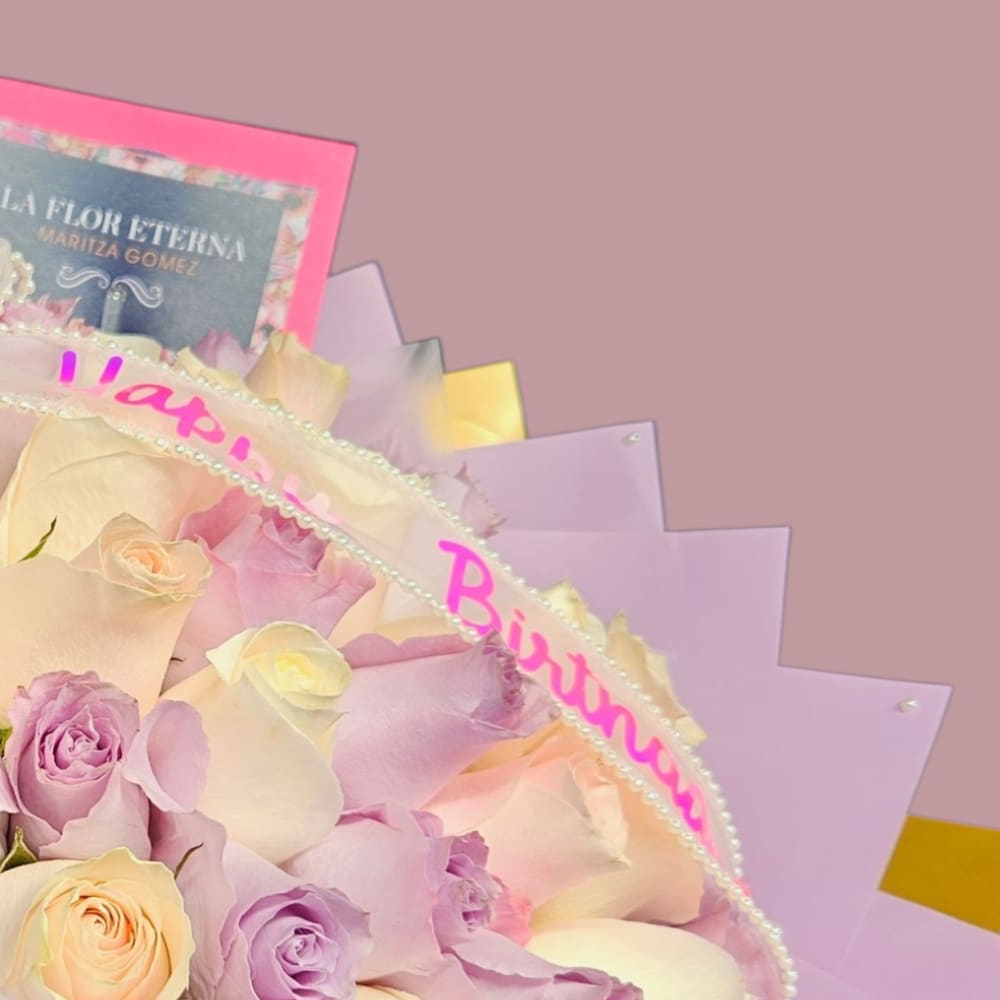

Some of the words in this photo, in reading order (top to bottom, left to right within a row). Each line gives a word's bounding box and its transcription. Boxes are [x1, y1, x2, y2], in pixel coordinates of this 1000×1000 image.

[0, 185, 36, 217] LA
[44, 194, 122, 238] FLOR
[127, 216, 247, 262] ETERNA
[38, 226, 120, 260] MARITZA
[124, 247, 201, 277] GOMEZ
